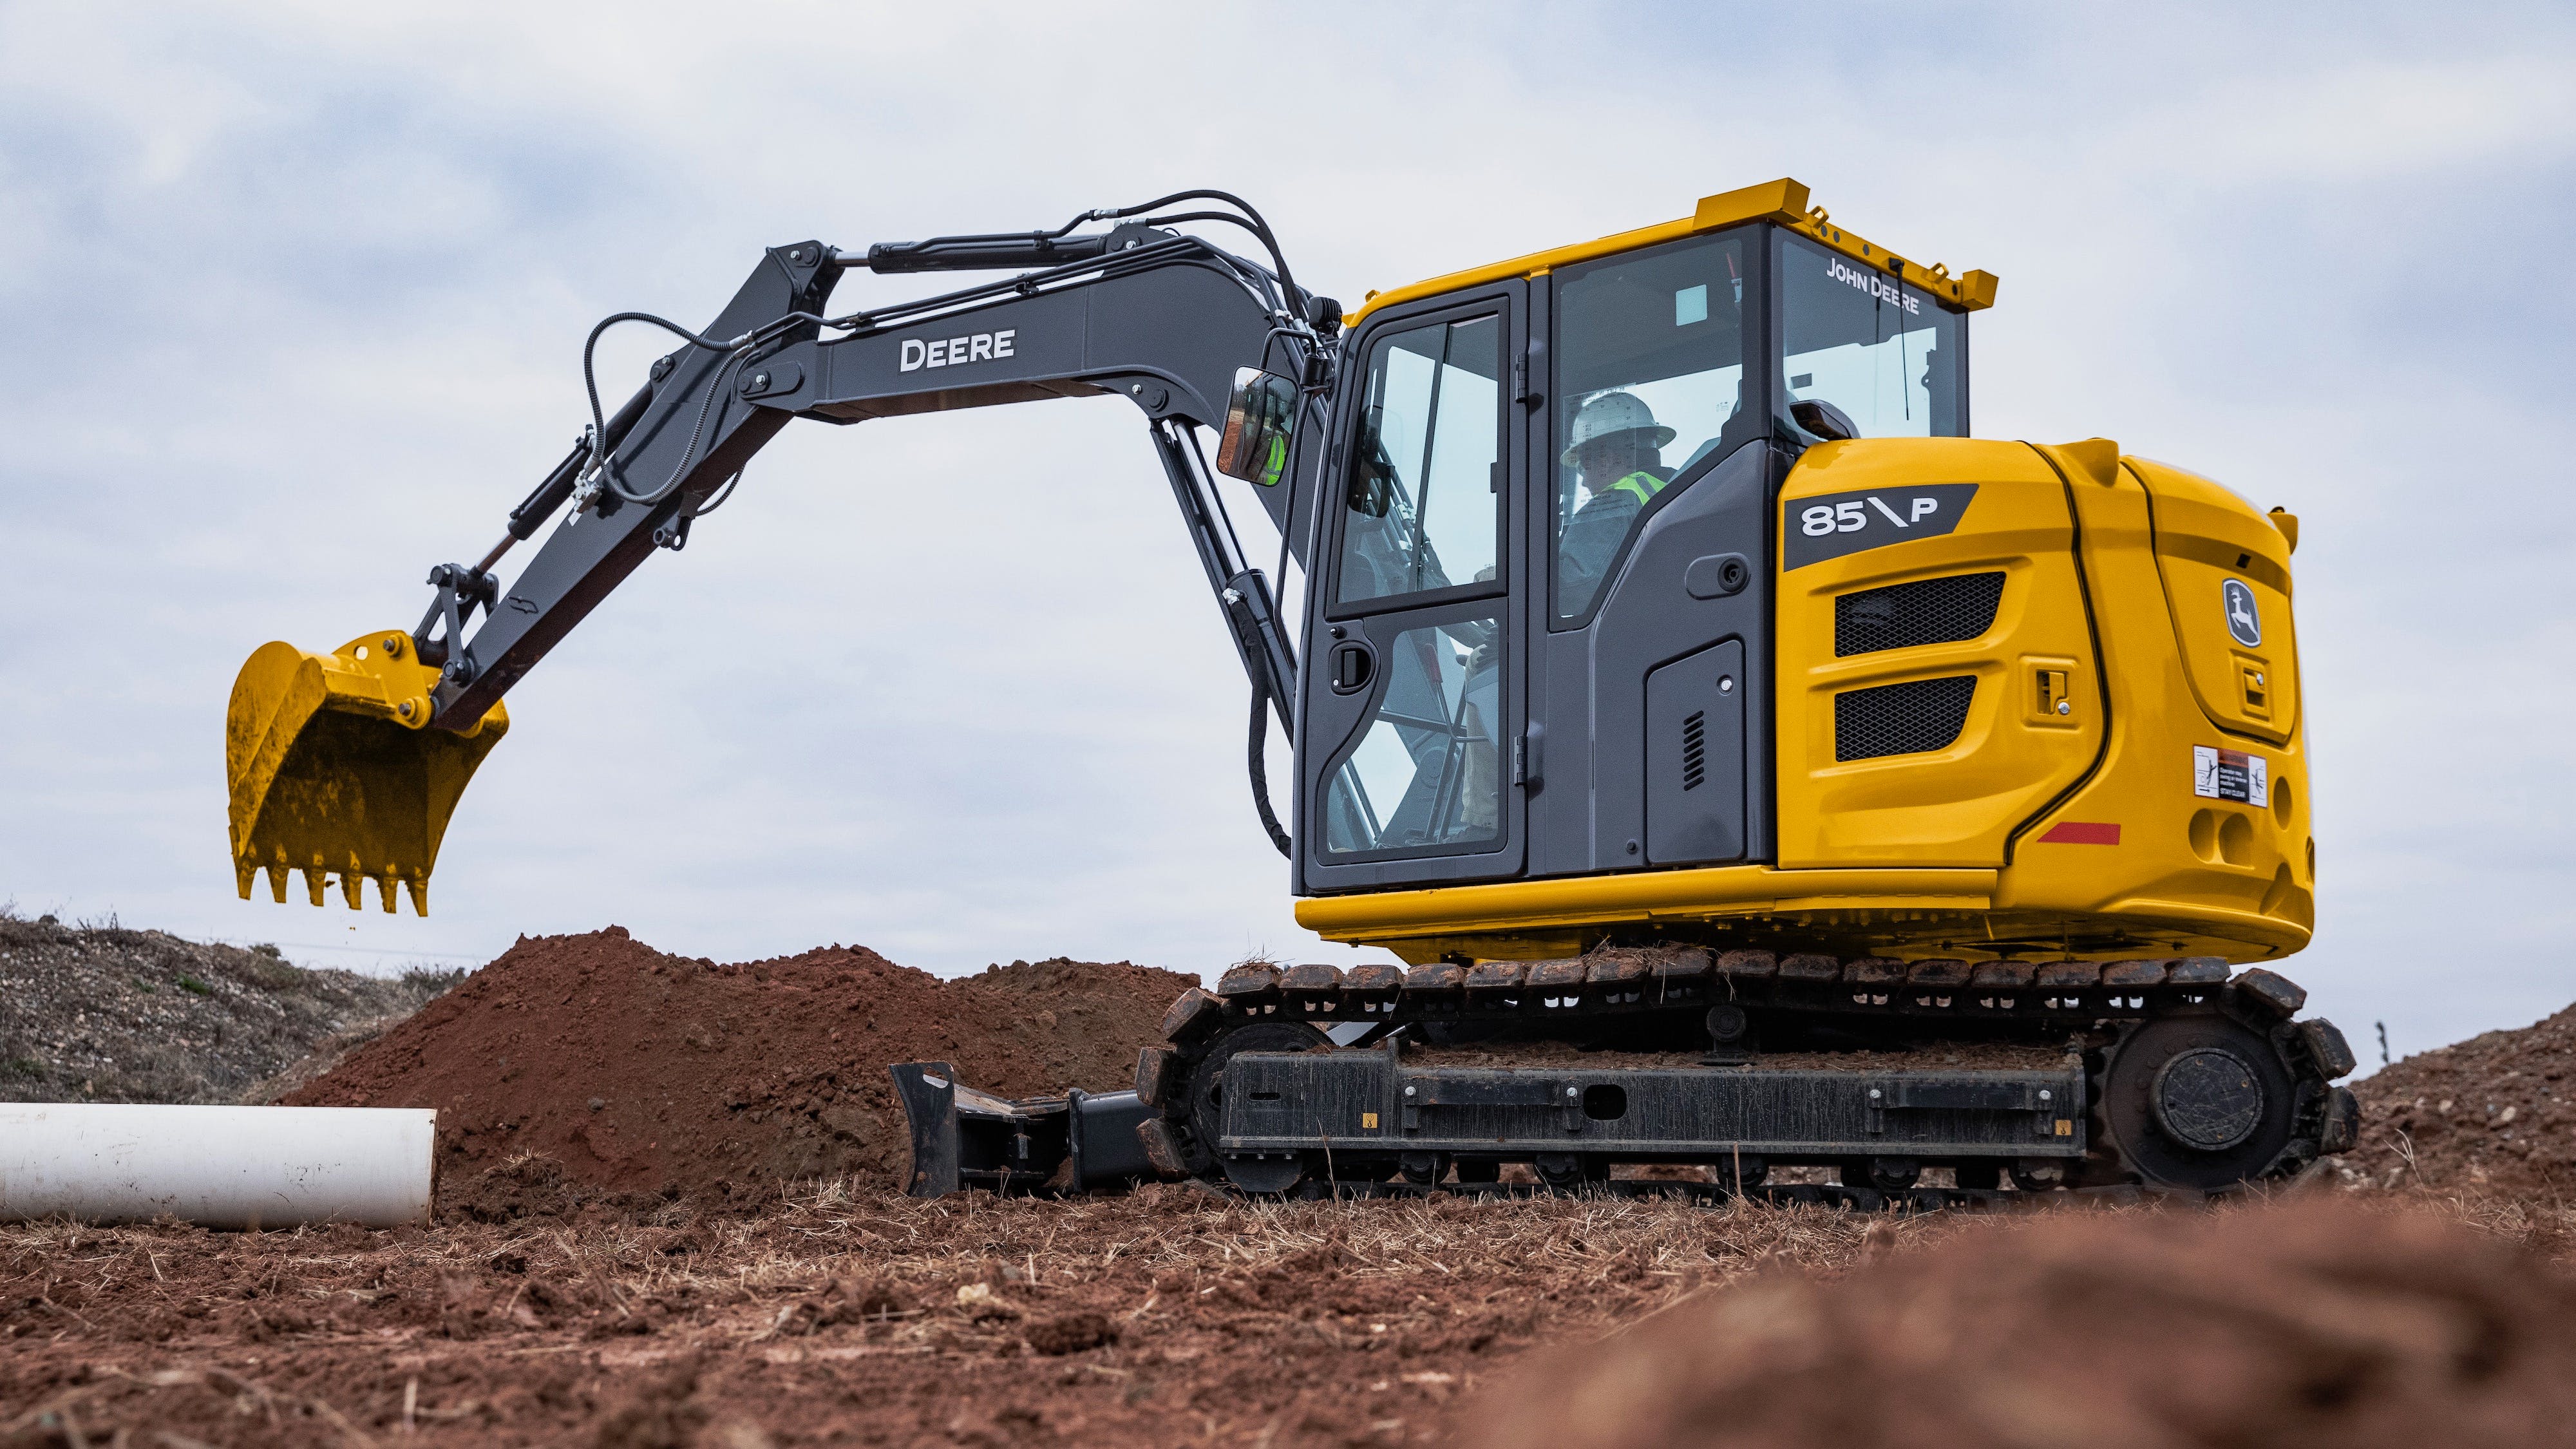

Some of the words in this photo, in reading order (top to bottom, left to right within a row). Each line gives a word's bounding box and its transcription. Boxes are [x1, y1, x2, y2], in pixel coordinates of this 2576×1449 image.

[1826, 258, 1868, 292] JOHN
[1870, 276, 1919, 316] DEERE
[900, 329, 1016, 372] DEERE
[2231, 790, 2246, 798] CLEAR
